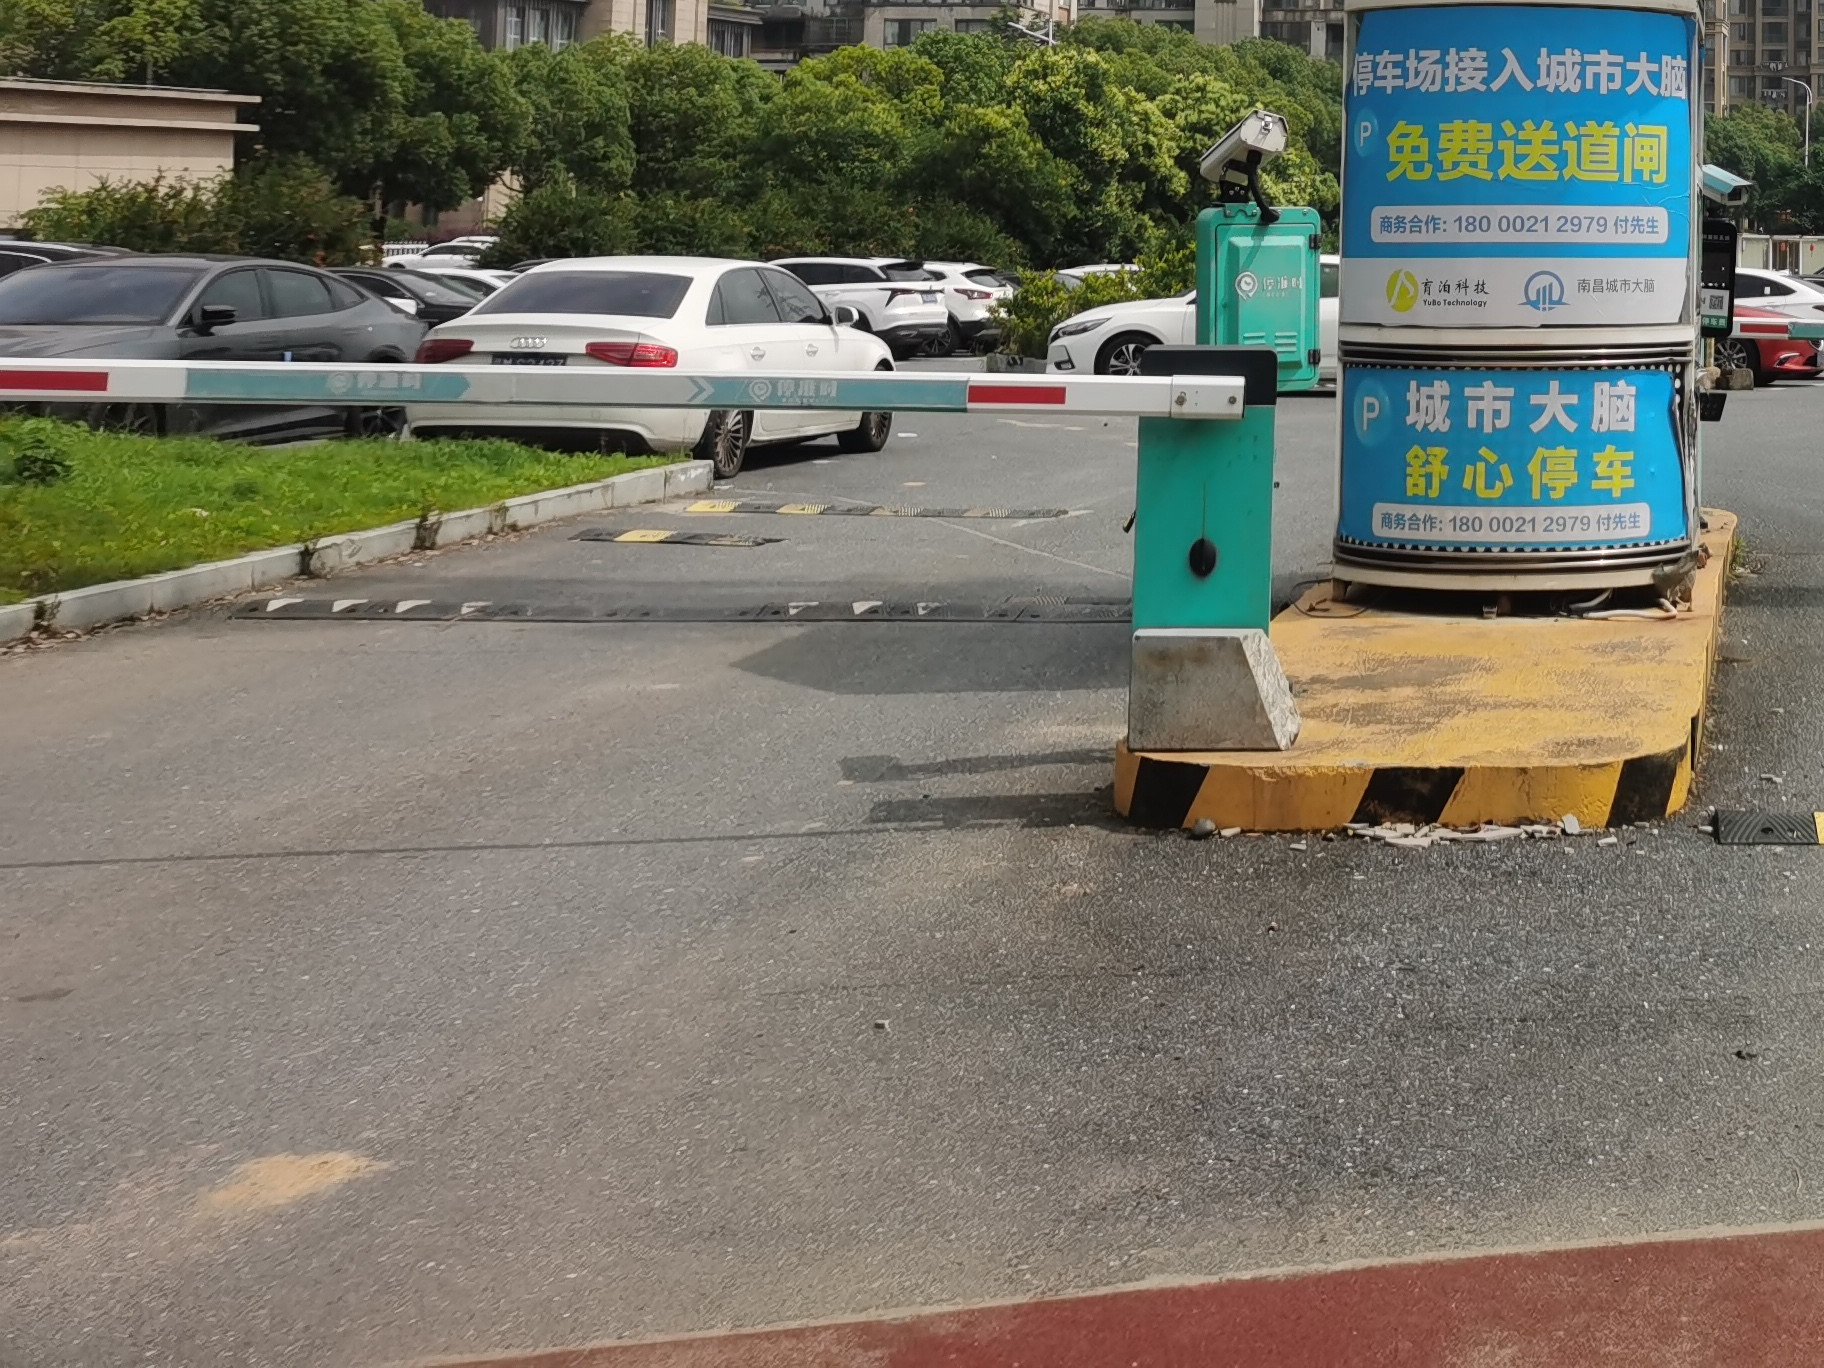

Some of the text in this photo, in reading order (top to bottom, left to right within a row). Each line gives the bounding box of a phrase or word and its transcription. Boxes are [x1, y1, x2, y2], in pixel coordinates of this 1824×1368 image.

[1352, 48, 1687, 99] 停车场接入城市大脑
[1386, 120, 1667, 183] 免费送道闸
[1453, 216, 1491, 233] 180
[1498, 216, 1549, 233] 0021
[1556, 216, 1608, 233] 2979
[1614, 216, 1659, 234] 付先生
[1421, 278, 1490, 295] 育泊科技
[1577, 278, 1655, 293] 南昌城市大脑
[1423, 299, 1487, 307] YuBo Technology
[1406, 379, 1637, 433] 城市大脑
[1405, 444, 1635, 499] 舒心停车
[1449, 516, 1482, 532] 180
[1489, 516, 1536, 532] 0021
[1543, 516, 1591, 532] 2979
[1596, 512, 1640, 530] 付先生
